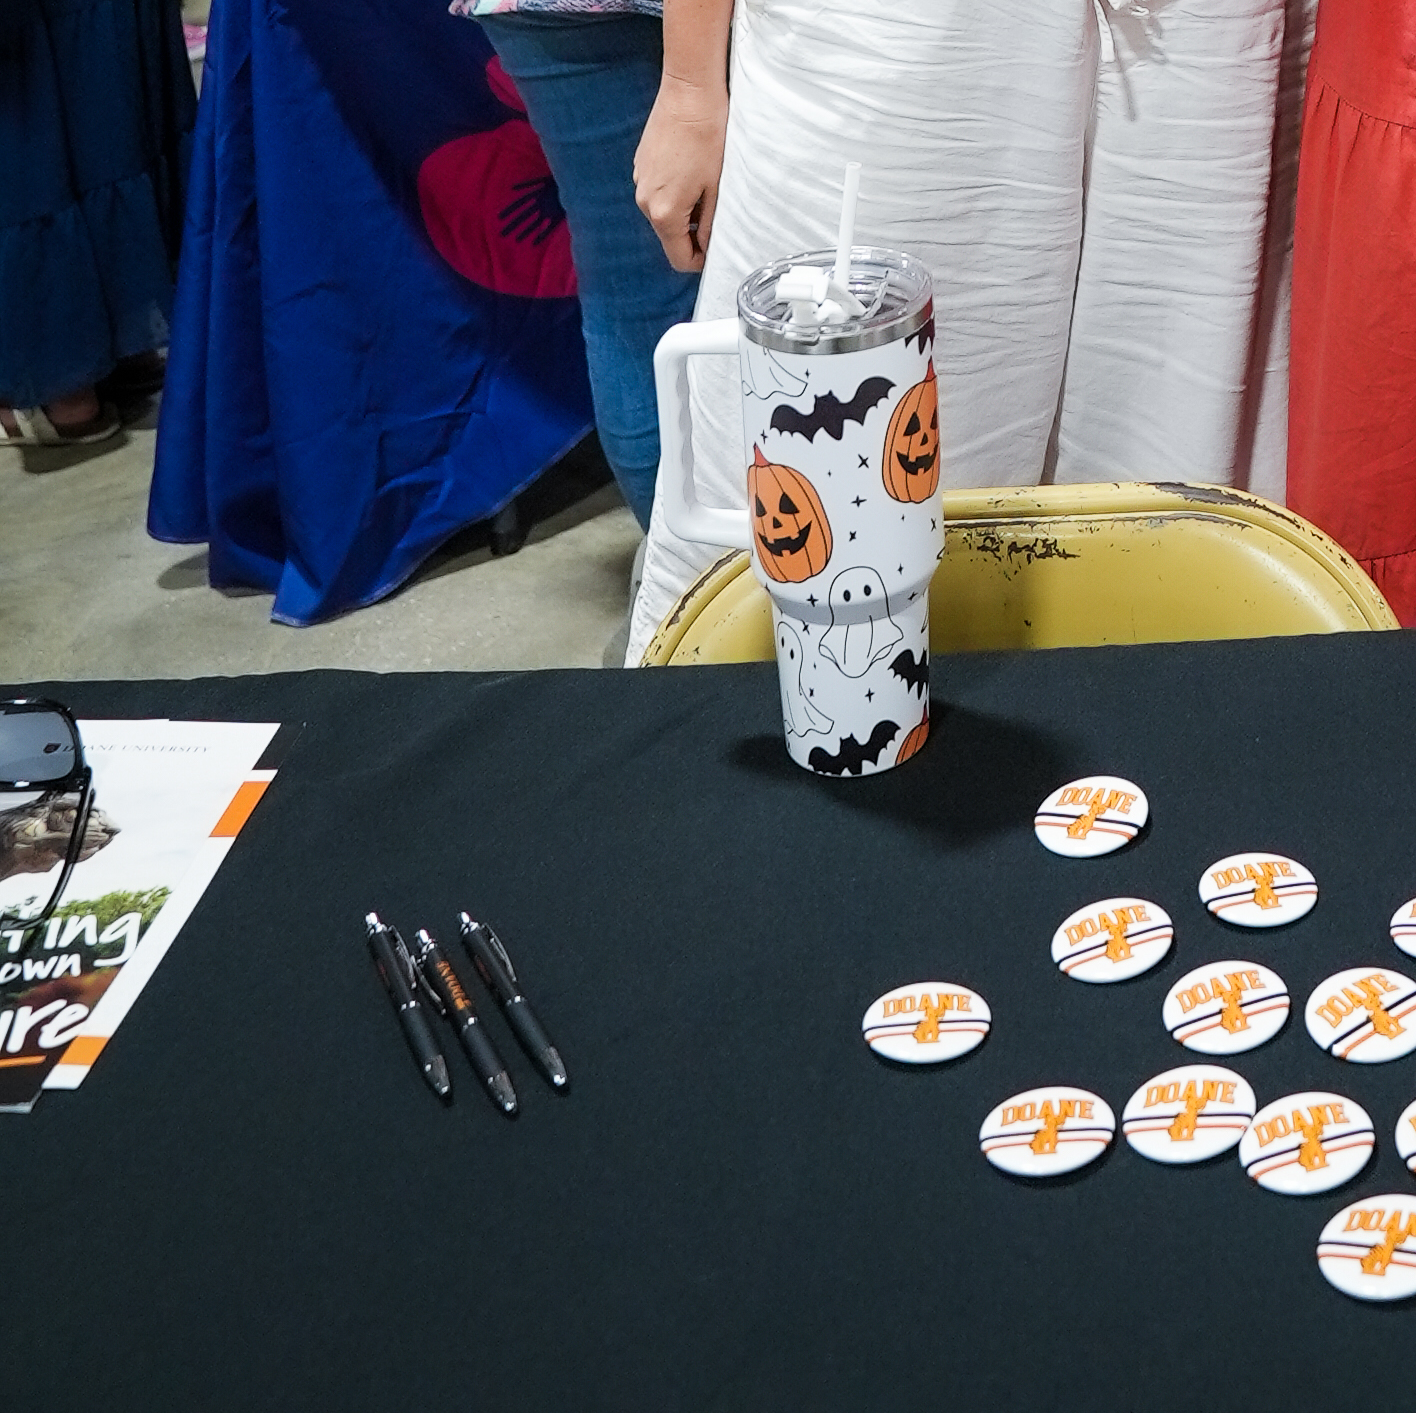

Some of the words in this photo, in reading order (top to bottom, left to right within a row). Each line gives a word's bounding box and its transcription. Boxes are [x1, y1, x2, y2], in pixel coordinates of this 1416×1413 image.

[121, 744, 211, 754] UNIVERSITY
[1057, 787, 1136, 814] DOANE
[1211, 861, 1296, 890] DOANE
[1064, 905, 1150, 945] DOANE
[882, 992, 972, 1017] DOANE
[1175, 969, 1266, 1013] DOANE
[1315, 973, 1400, 1028] DOANE
[1144, 1079, 1237, 1108] DOANE
[1000, 1099, 1094, 1127] DOANE
[1254, 1103, 1349, 1147] DOANE
